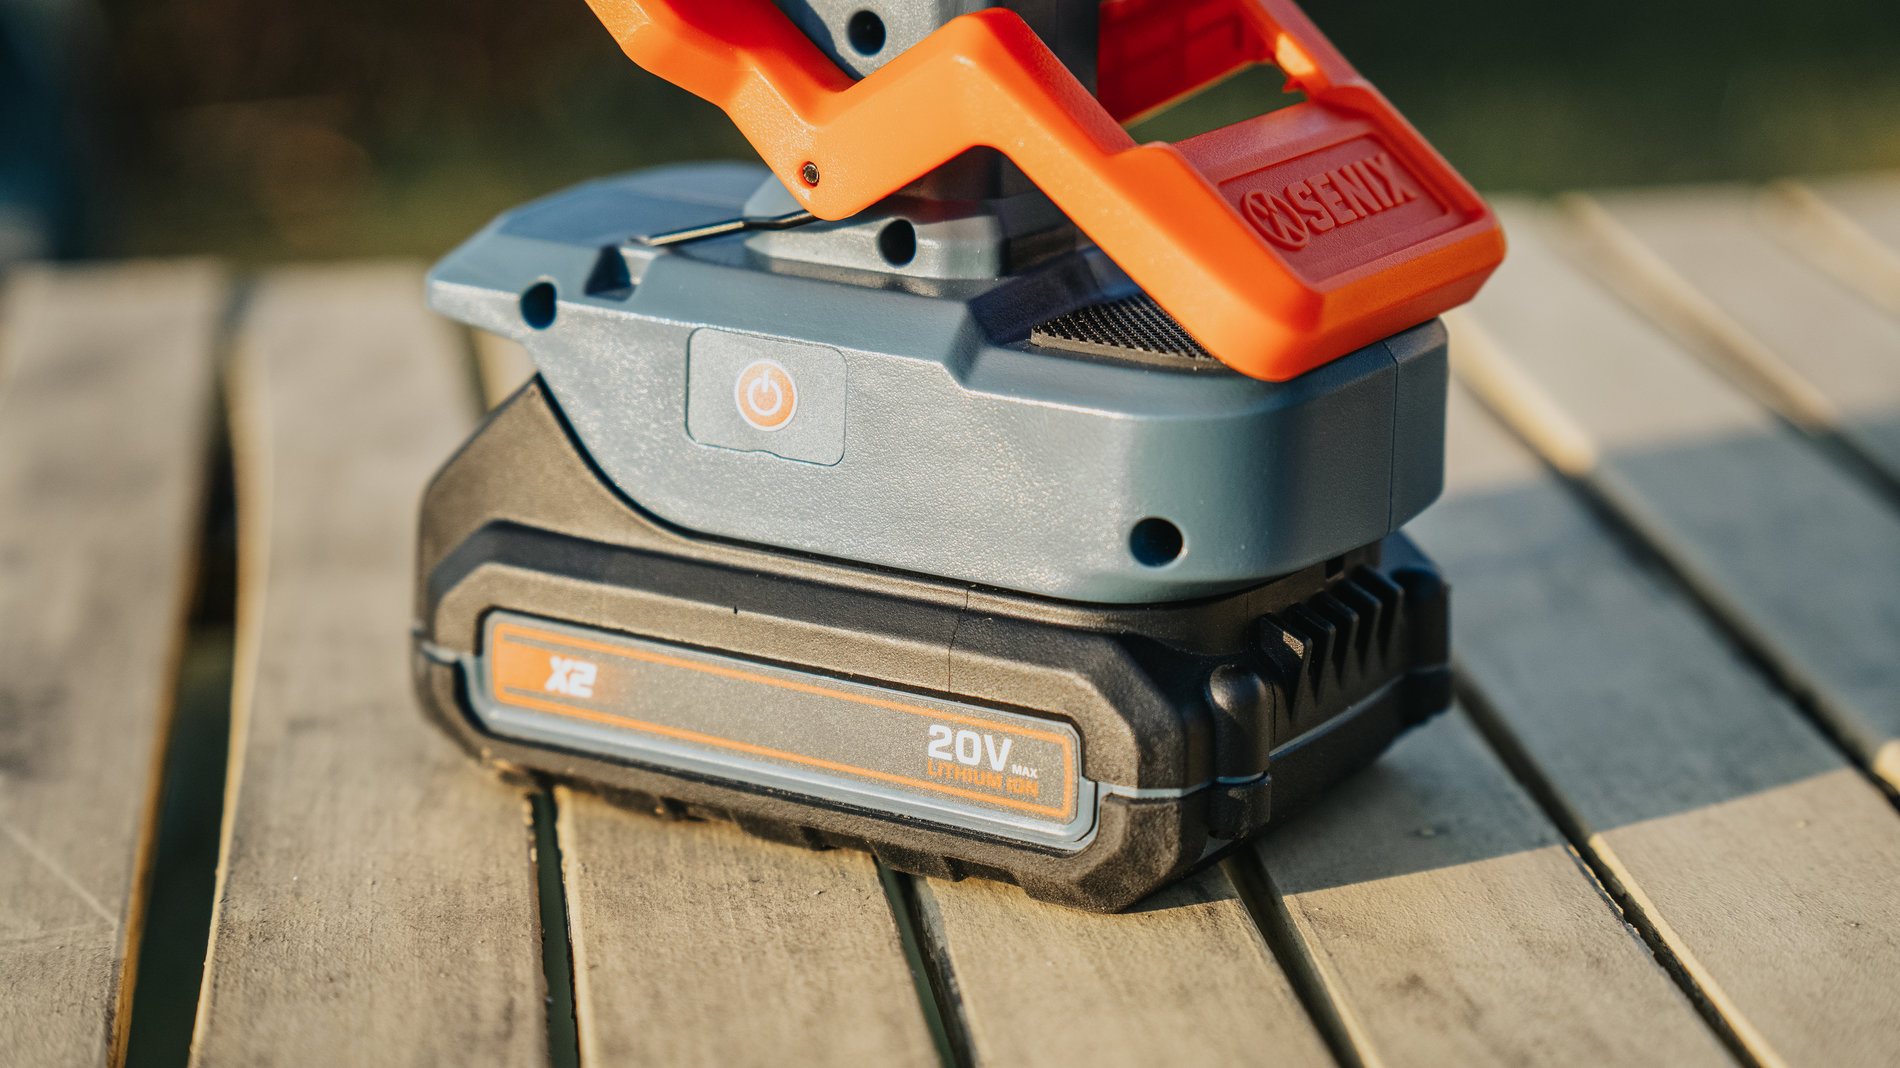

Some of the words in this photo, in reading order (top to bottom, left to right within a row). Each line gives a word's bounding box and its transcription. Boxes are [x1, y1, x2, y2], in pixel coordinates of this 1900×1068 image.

[1284, 152, 1417, 235] SENIX
[545, 655, 598, 698] X2
[928, 724, 1012, 771] 20V
[1012, 764, 1038, 778] MAX
[928, 760, 1002, 790] LITHIUM
